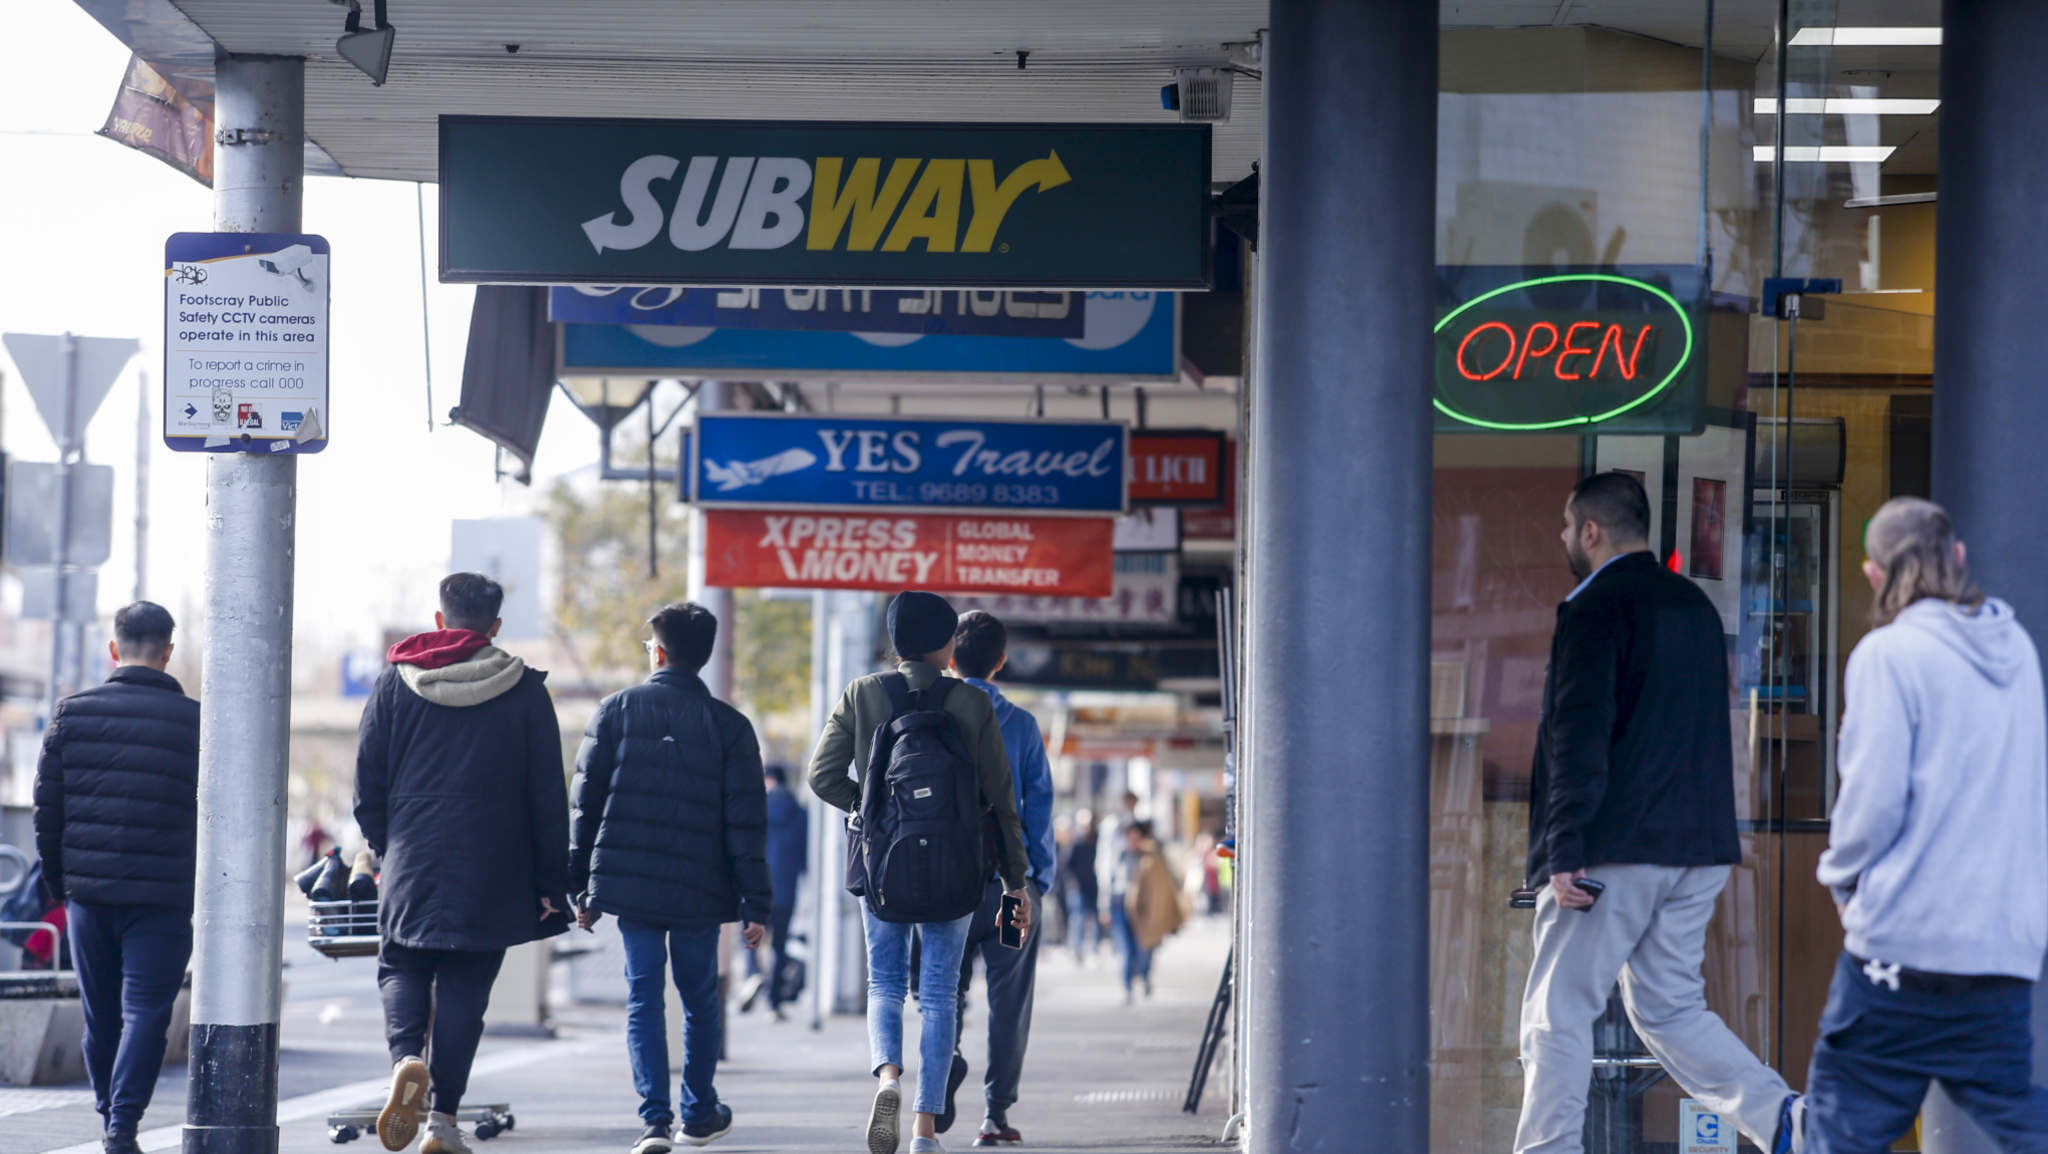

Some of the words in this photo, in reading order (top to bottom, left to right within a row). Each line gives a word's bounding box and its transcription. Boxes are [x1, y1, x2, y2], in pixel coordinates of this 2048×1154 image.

[581, 149, 1072, 255] SUBWAY
[180, 294, 244, 307] Footscray
[249, 295, 289, 307] Public
[179, 312, 218, 325] Safety
[221, 313, 256, 324] CCTV
[259, 314, 316, 325] cameras
[179, 330, 234, 343] operate
[239, 330, 251, 341] in
[256, 331, 278, 342] this
[283, 333, 315, 342] area
[1457, 321, 1651, 381] OPEN
[189, 358, 202, 370] To
[206, 360, 241, 373] report
[244, 362, 253, 371] a
[256, 360, 291, 371] crime
[294, 360, 304, 372] in
[189, 376, 246, 390] progress
[250, 377, 274, 389] call
[278, 378, 304, 389] 000
[817, 430, 922, 472] YES
[936, 430, 1114, 477] Travel
[850, 481, 911, 500] TEL:
[919, 485, 987, 502] 9689
[992, 486, 1059, 504] 8383
[758, 515, 917, 549] XPRESS
[957, 522, 1034, 541] GLOBAL
[956, 545, 1029, 563] MONEY
[799, 551, 938, 583] MONEY
[956, 567, 1060, 587] TRANSFER
